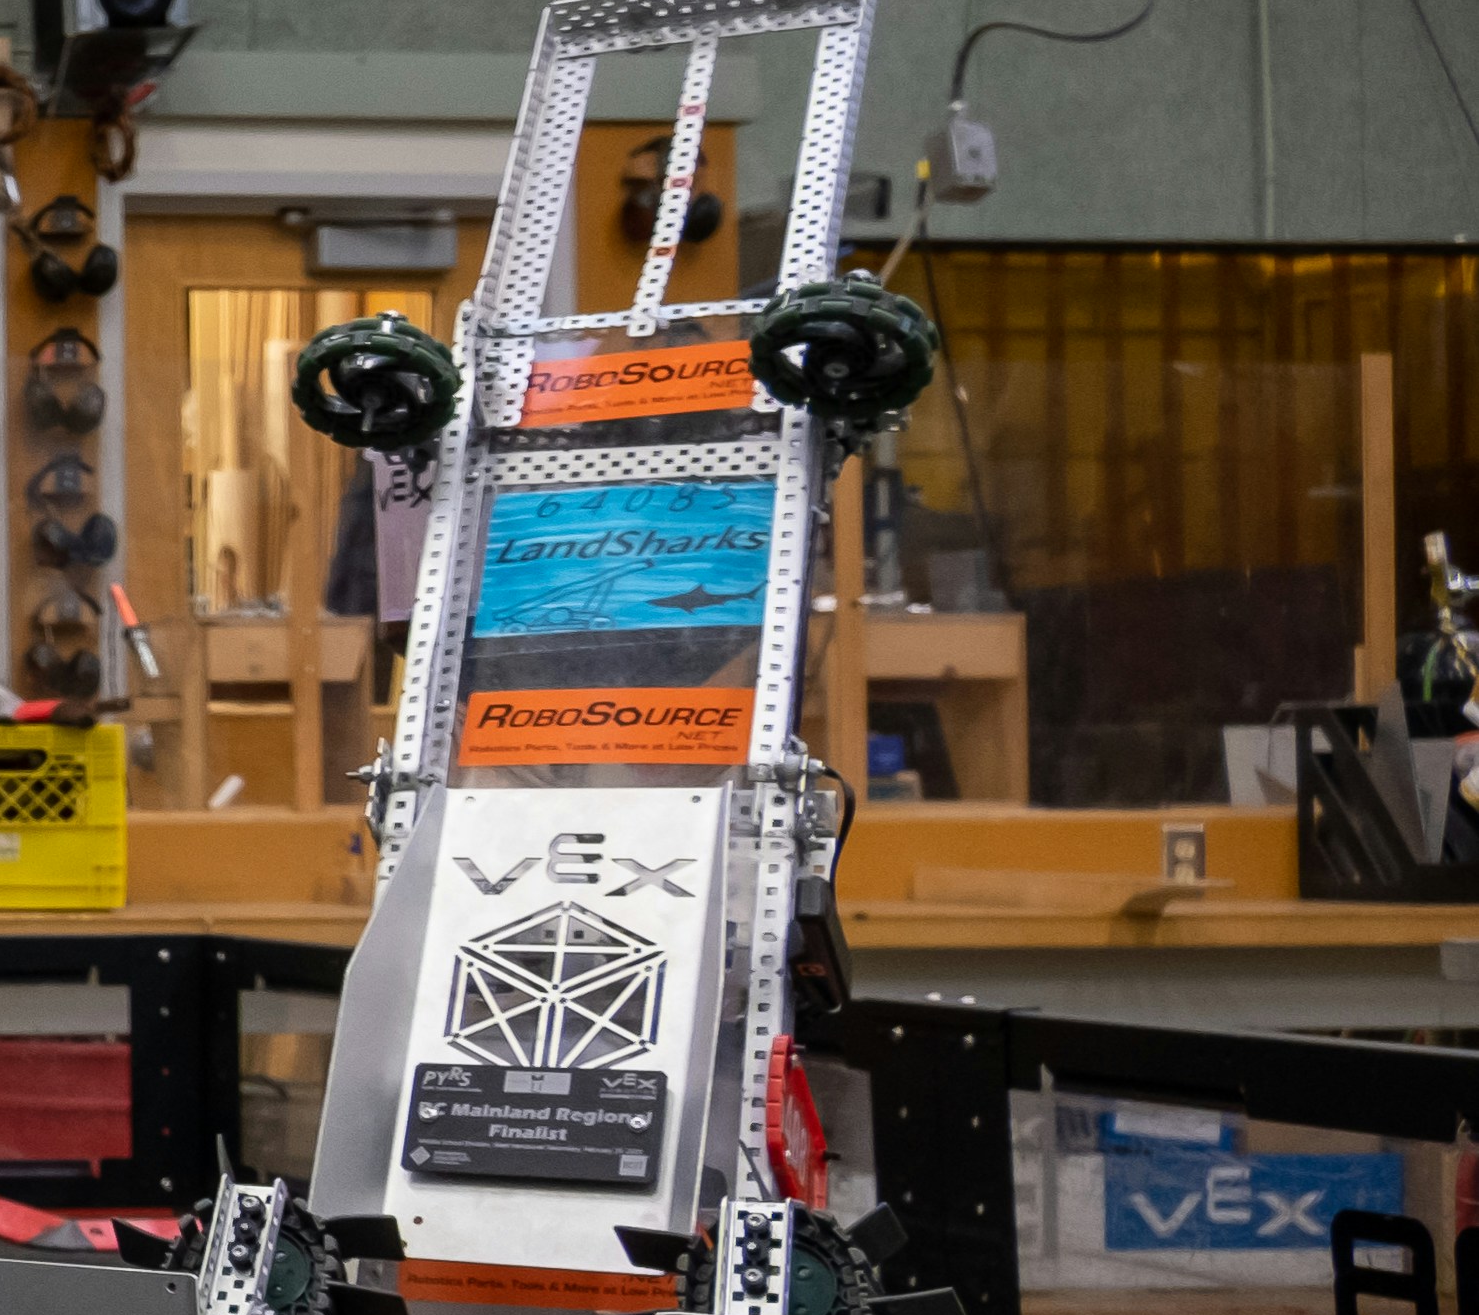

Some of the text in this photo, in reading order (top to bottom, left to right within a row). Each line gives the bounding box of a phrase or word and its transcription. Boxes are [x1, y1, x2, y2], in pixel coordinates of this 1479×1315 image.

[527, 358, 751, 394] ROBOSOURC
[495, 525, 769, 564] LandSharks
[478, 701, 743, 728] ROBOSOURCE
[453, 833, 698, 897] VEX
[422, 1066, 473, 1087] PYRS
[602, 1073, 658, 1089] VEX
[450, 1103, 551, 1121] Mainland
[556, 1107, 653, 1126] Regionl
[488, 1124, 568, 1141] Finalist
[1130, 1165, 1330, 1239] VEX
